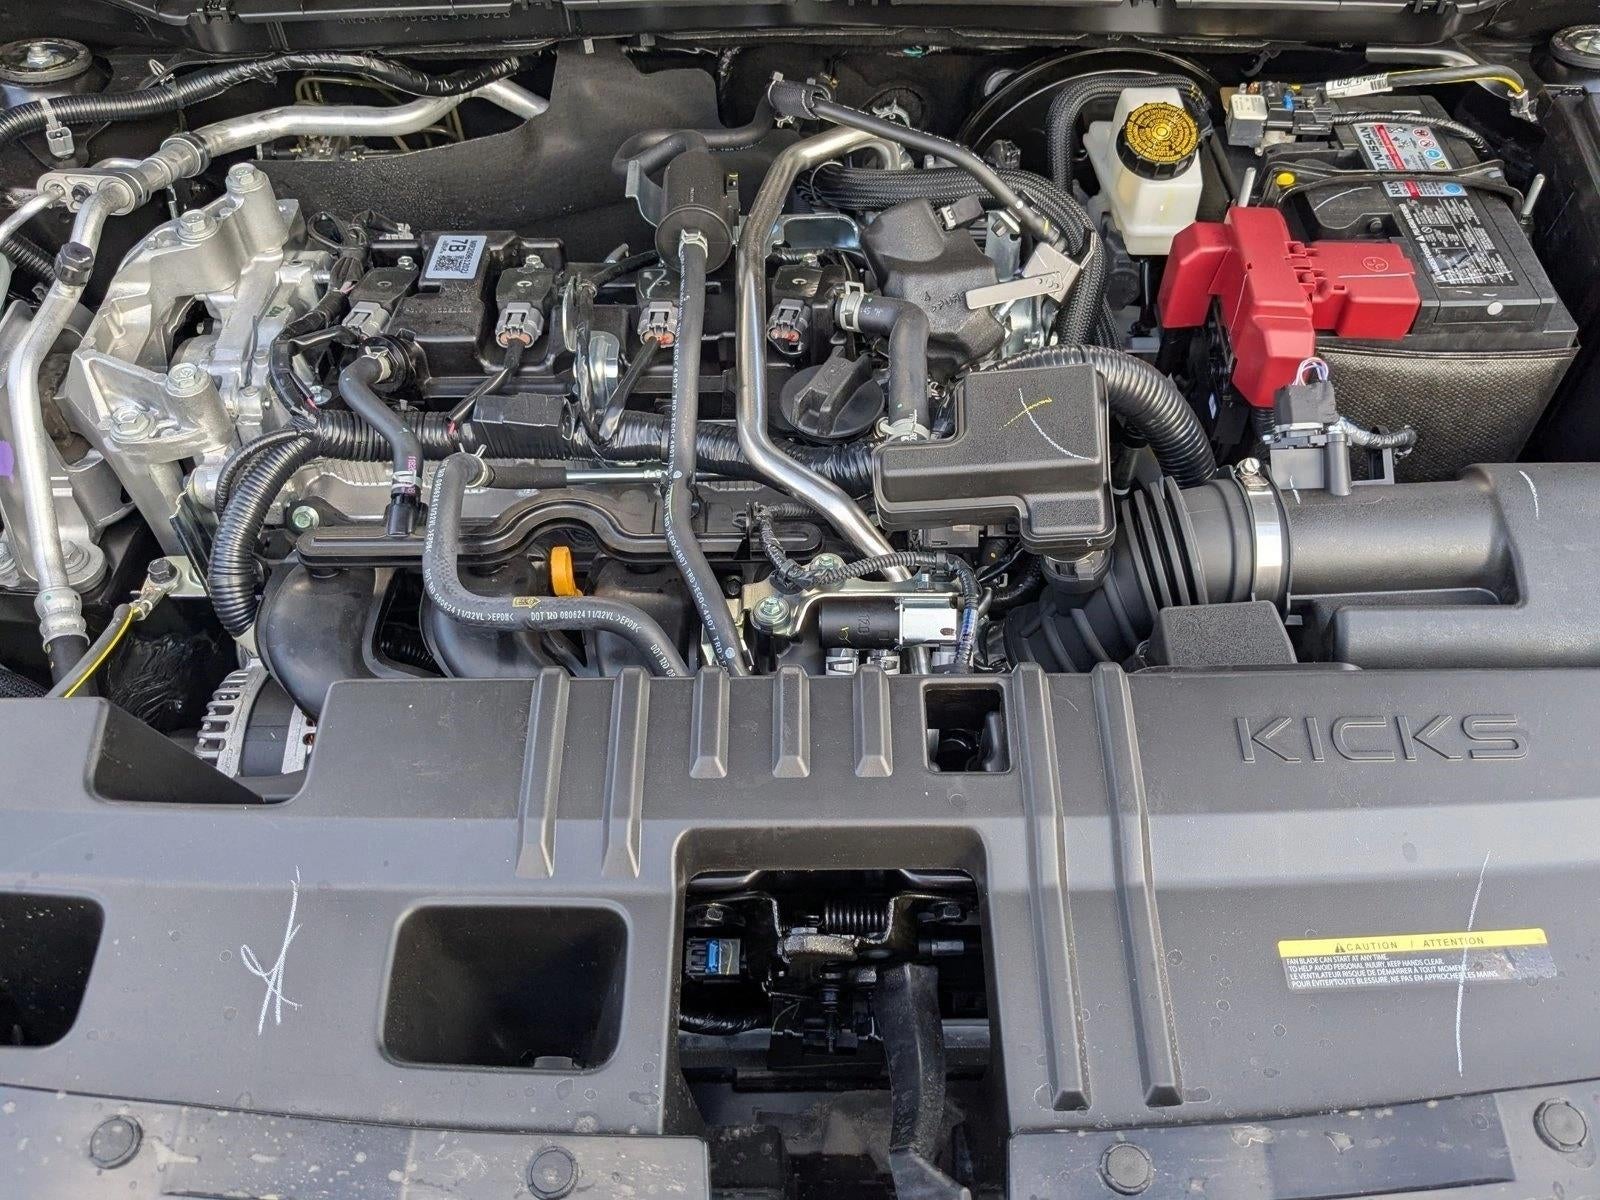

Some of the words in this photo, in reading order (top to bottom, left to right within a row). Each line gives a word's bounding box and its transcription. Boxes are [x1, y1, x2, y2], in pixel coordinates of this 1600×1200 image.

[449, 239, 468, 252] 7B
[531, 612, 544, 621] DOT
[560, 609, 586, 620] 080624
[650, 643, 664, 657] DOT
[1235, 714, 1528, 762] KICKS
[1347, 941, 1398, 952] CAUTION
[1423, 935, 1485, 948] ATTENTION
[1286, 958, 1299, 966] FAN
[1299, 957, 1319, 965] BLADE
[1320, 956, 1332, 964] CAN
[1288, 965, 1298, 973] TO
[1299, 965, 1314, 973] HELP
[1314, 964, 1333, 972] AVOID
[1334, 962, 1365, 971] PERSONAL
[1386, 960, 1401, 968] KEEP
[1290, 973, 1298, 981] LE
[1298, 971, 1341, 980] VENTILATEUR
[1342, 970, 1367, 978] RISQUE
[1367, 969, 1376, 977] DE
[1419, 966, 1438, 974] TOUT
[1291, 981, 1311, 989] POUR
[1333, 978, 1356, 987] TOUTE
